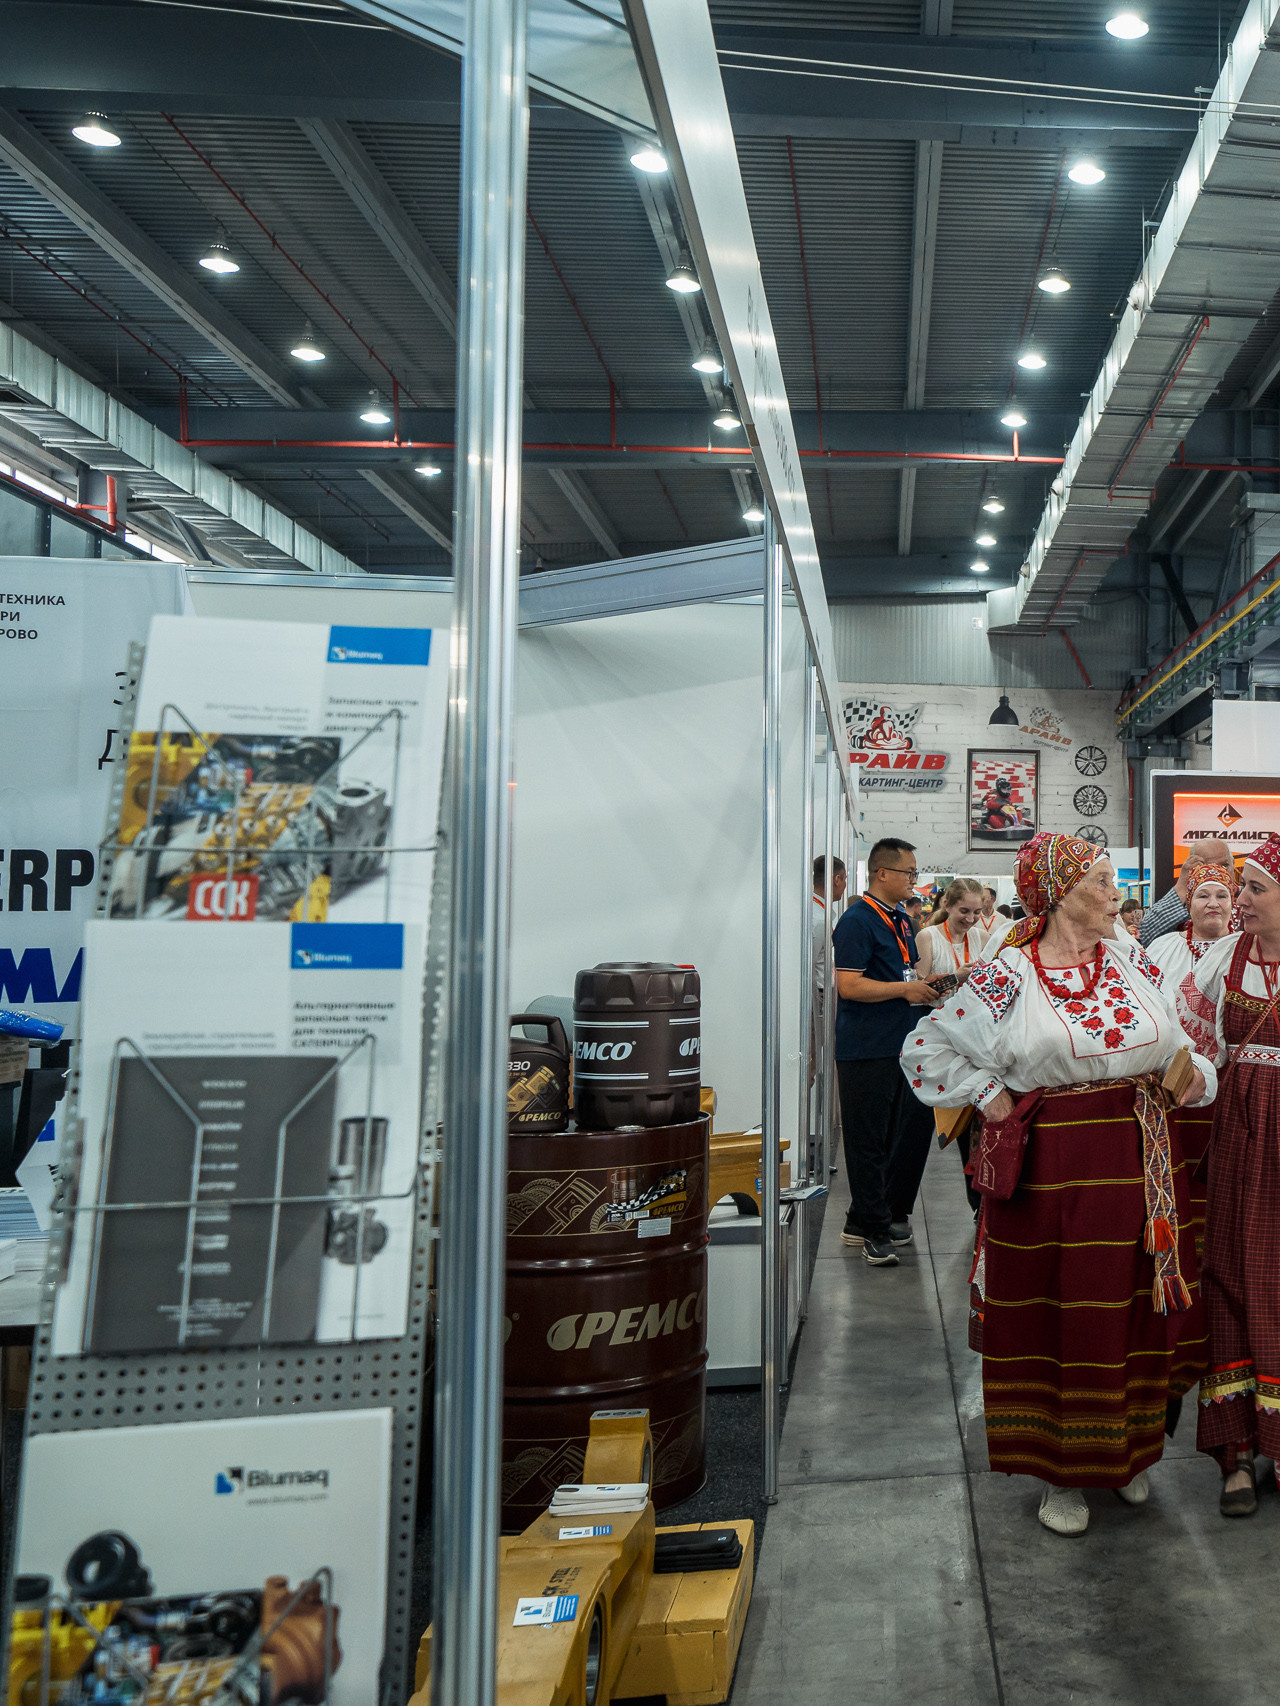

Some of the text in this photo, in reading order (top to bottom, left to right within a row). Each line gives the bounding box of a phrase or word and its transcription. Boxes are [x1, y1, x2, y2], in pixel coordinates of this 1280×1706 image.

[858, 777, 943, 790] КАРТИНГ-ЦЕНТР
[293, 1001, 396, 1010] Альтернативные
[292, 1028, 315, 1036] для
[525, 1112, 561, 1122] PEMCO
[247, 1470, 329, 1489] Blumaq
